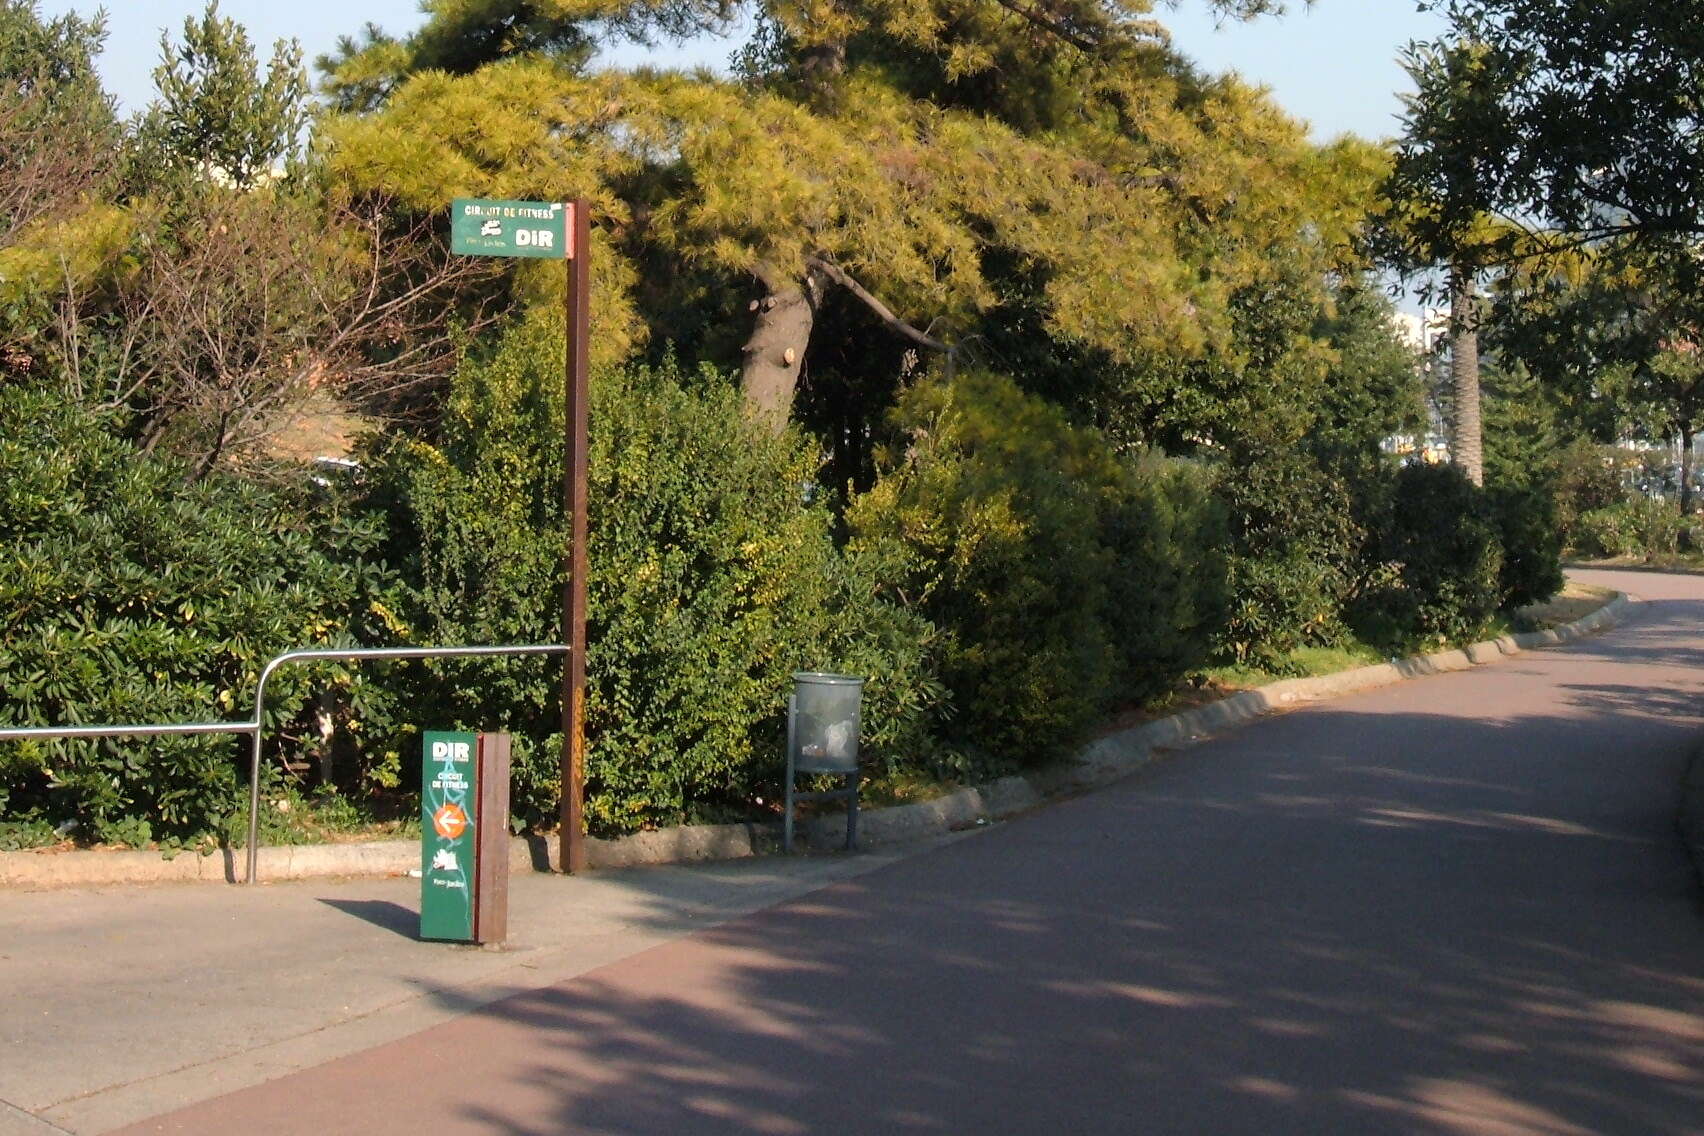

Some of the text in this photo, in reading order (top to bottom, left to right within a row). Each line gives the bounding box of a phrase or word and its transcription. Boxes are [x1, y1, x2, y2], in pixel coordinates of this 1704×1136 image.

[464, 205, 554, 219] CIRUIT DE FITNESS
[516, 229, 554, 247] DIR
[432, 741, 469, 758] DIR
[432, 780, 441, 788] DE
